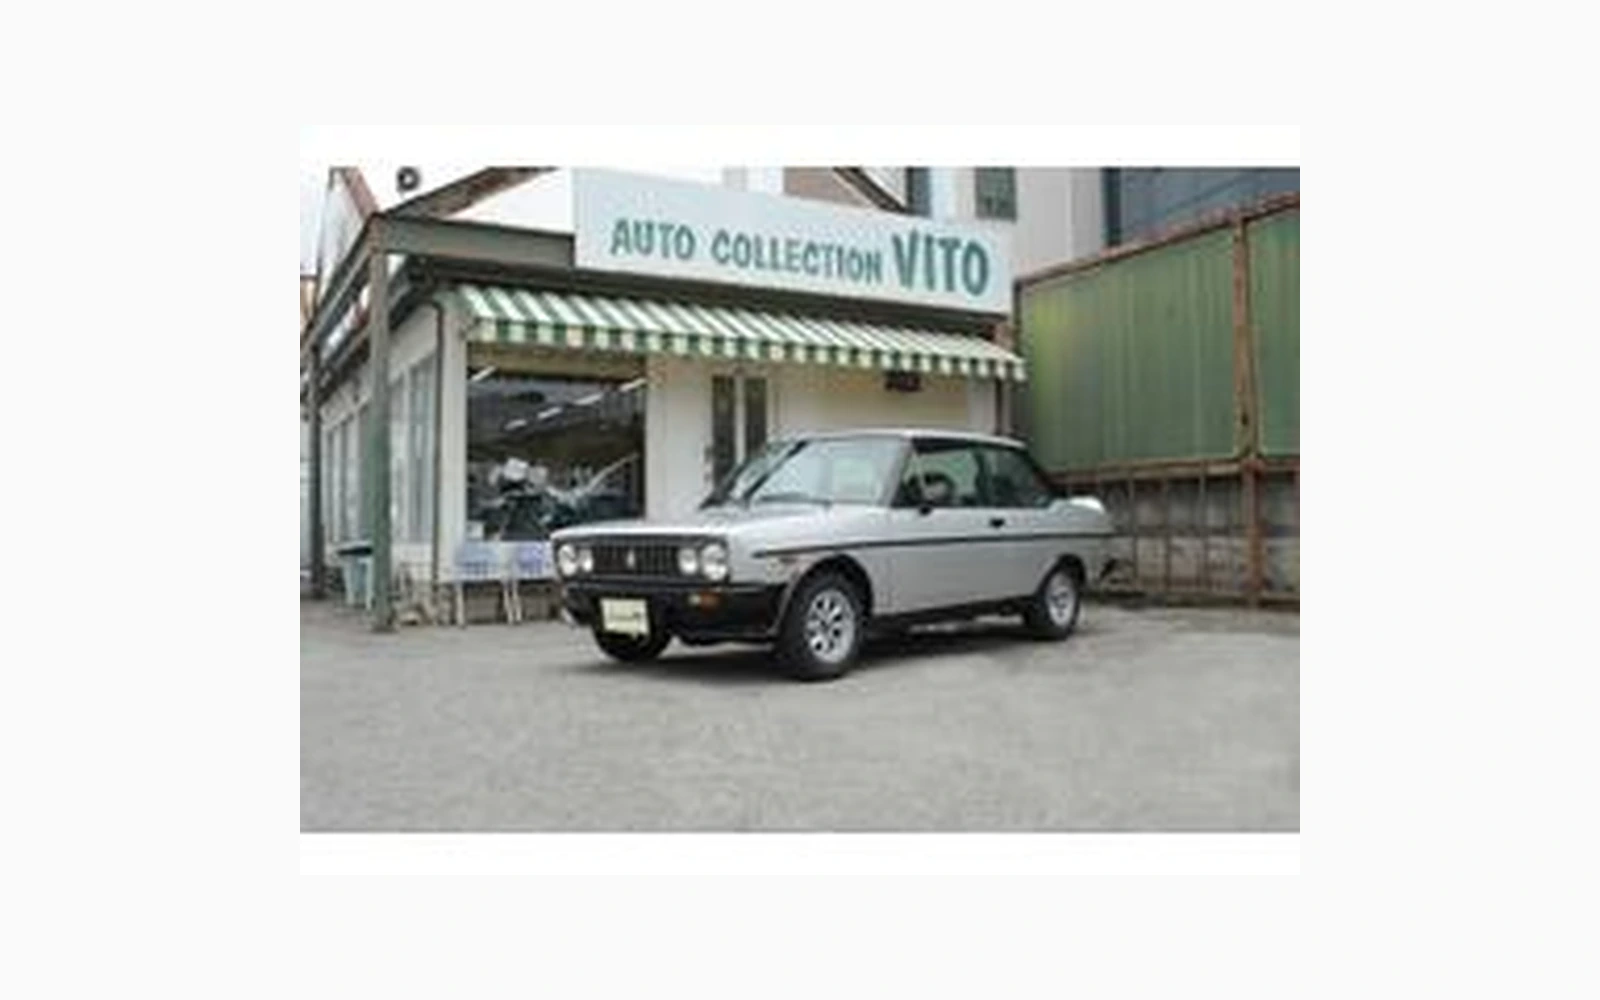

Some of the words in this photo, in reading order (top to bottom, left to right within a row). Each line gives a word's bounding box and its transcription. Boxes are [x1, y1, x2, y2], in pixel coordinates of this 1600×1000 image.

[610, 217, 696, 261] AUTO
[710, 230, 882, 282] COLLECTION
[892, 230, 990, 296] VITO
